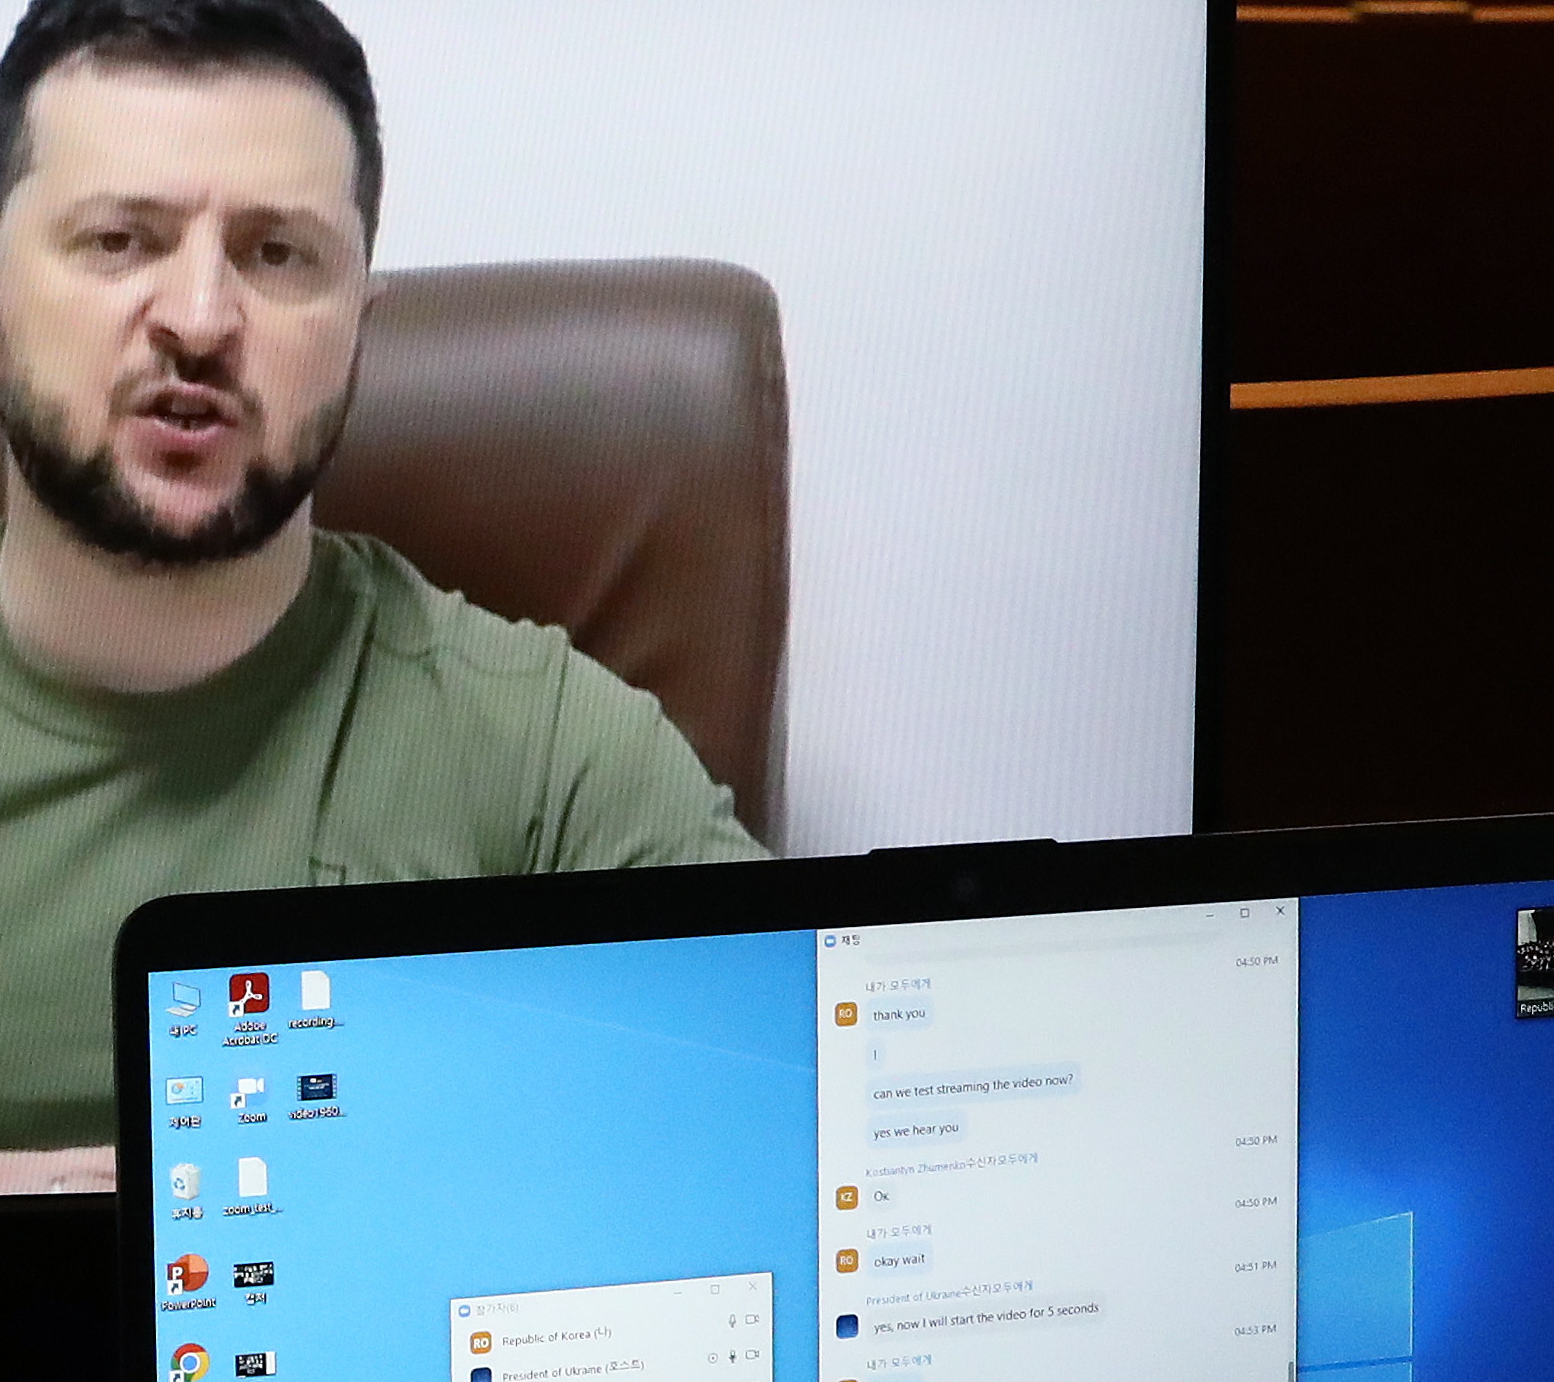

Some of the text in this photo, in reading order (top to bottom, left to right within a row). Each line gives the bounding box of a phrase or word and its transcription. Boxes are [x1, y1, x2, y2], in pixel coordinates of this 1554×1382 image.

[873, 1007, 926, 1022] thank you
[873, 1073, 1074, 1100] can we test streaming the video now?
[238, 1112, 267, 1124] Zoom
[873, 1122, 959, 1140] yes we hear you
[874, 1252, 926, 1270] okay wait
[897, 1319, 920, 1331] now
[928, 1315, 948, 1328] will
[950, 1313, 975, 1326] start
[977, 1312, 994, 1324] the
[997, 1308, 1027, 1322] video
[1029, 1306, 1045, 1319] for
[1048, 1306, 1054, 1317] 5
[1057, 1303, 1099, 1316] seconds
[473, 1337, 489, 1349] RO
[502, 1333, 544, 1348] Republic
[548, 1332, 558, 1343] of
[561, 1329, 591, 1341] Korea
[503, 1369, 549, 1382] President
[552, 1367, 562, 1378] of
